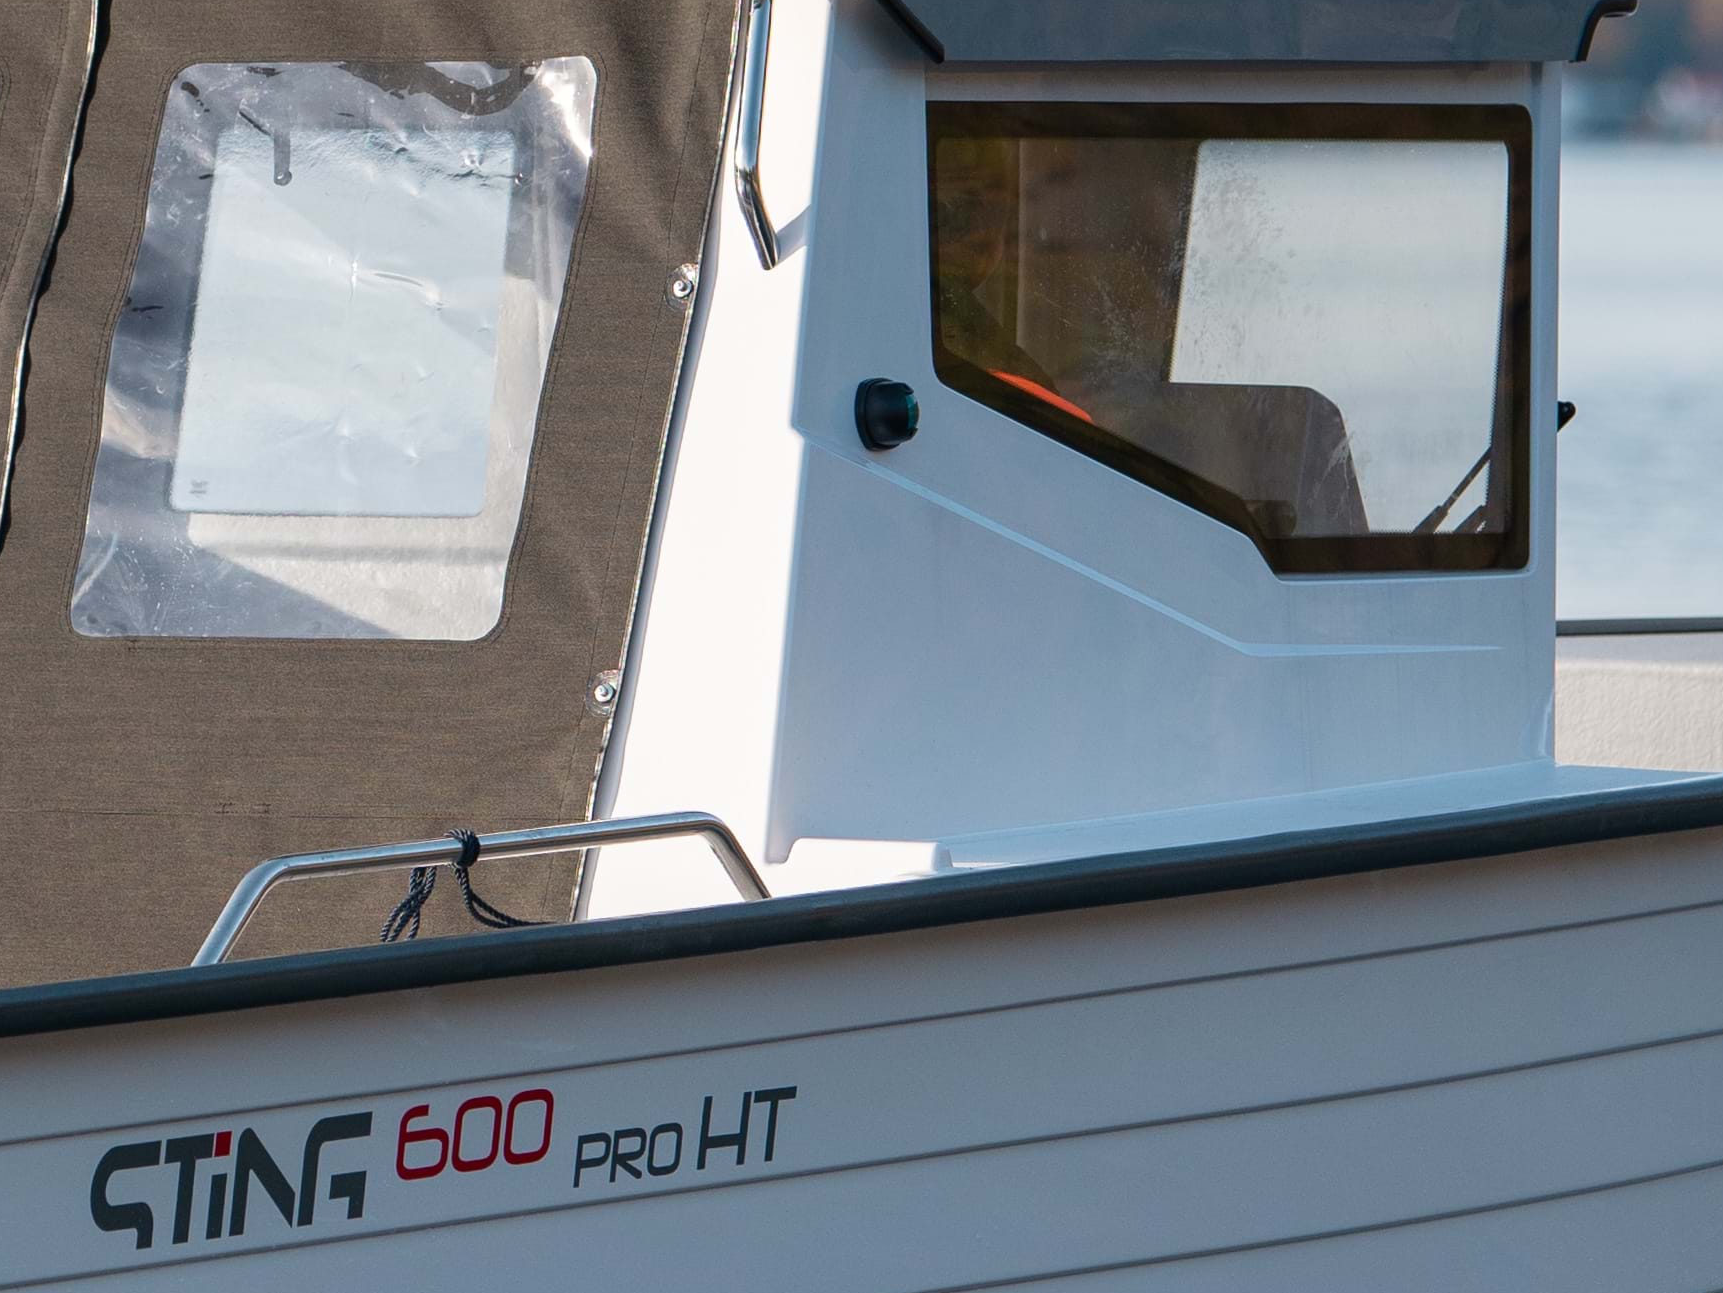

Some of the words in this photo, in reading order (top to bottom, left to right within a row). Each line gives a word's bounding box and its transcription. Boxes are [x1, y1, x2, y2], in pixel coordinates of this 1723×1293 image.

[397, 1089, 554, 1181] 600
[573, 1122, 683, 1188] PRO
[697, 1085, 798, 1170] HT
